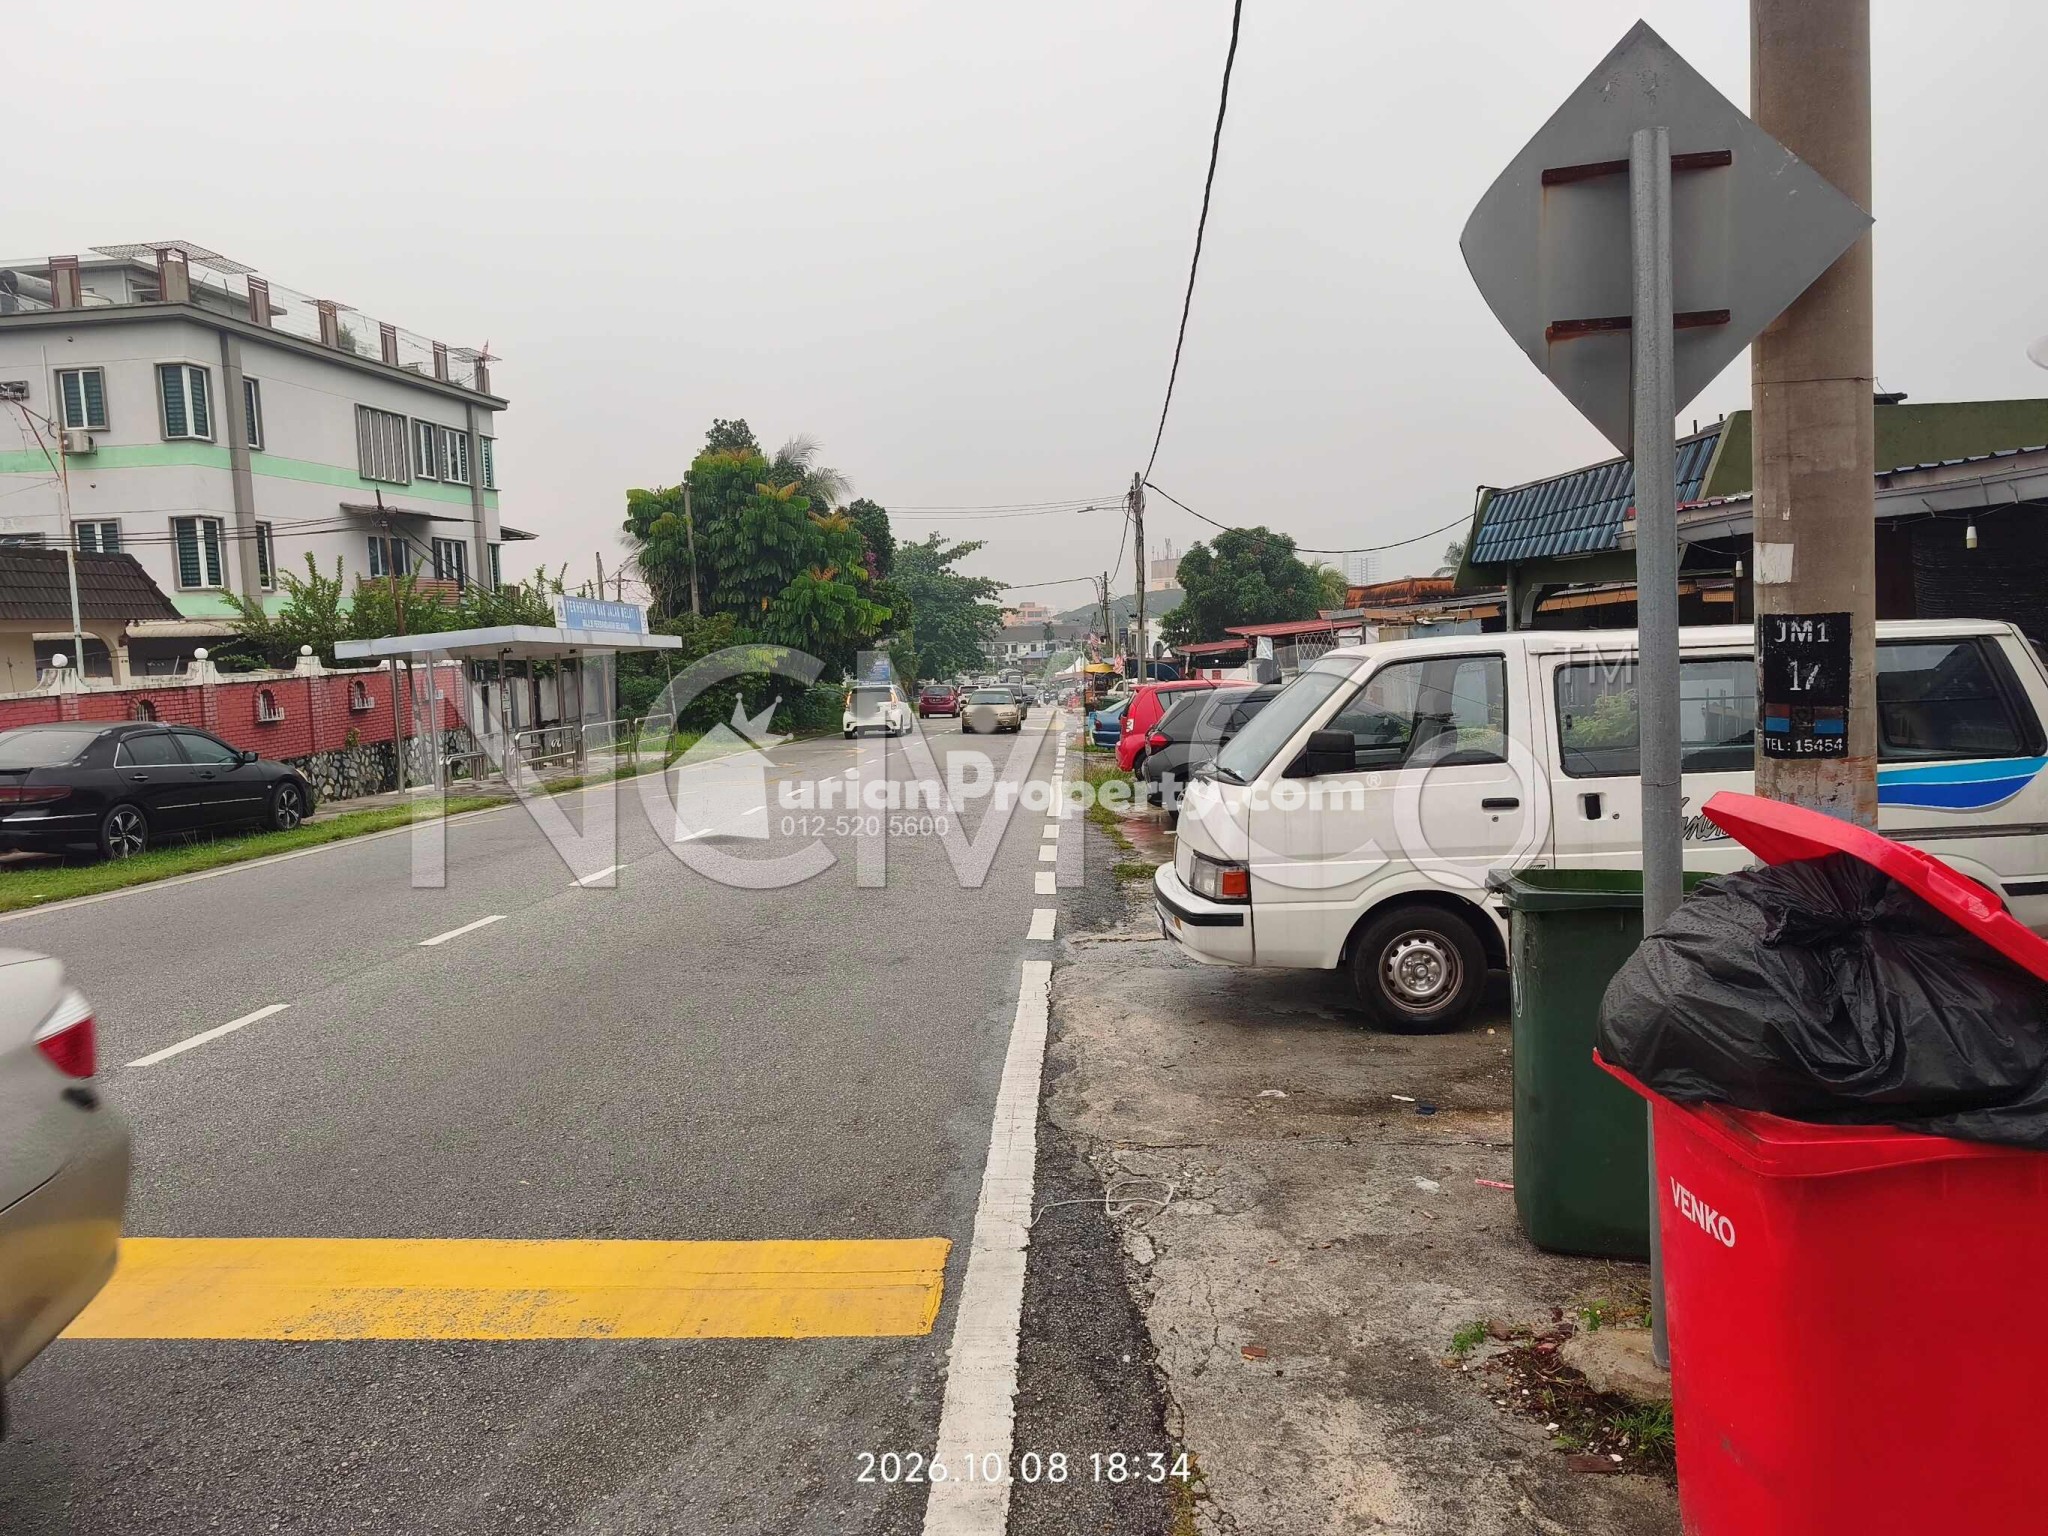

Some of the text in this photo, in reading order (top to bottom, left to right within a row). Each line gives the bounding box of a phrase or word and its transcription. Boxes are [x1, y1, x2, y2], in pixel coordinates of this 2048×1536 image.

[1774, 619, 1830, 643] JM1
[1795, 737, 1843, 752] 15454
[1670, 1175, 1736, 1248] VENKO
